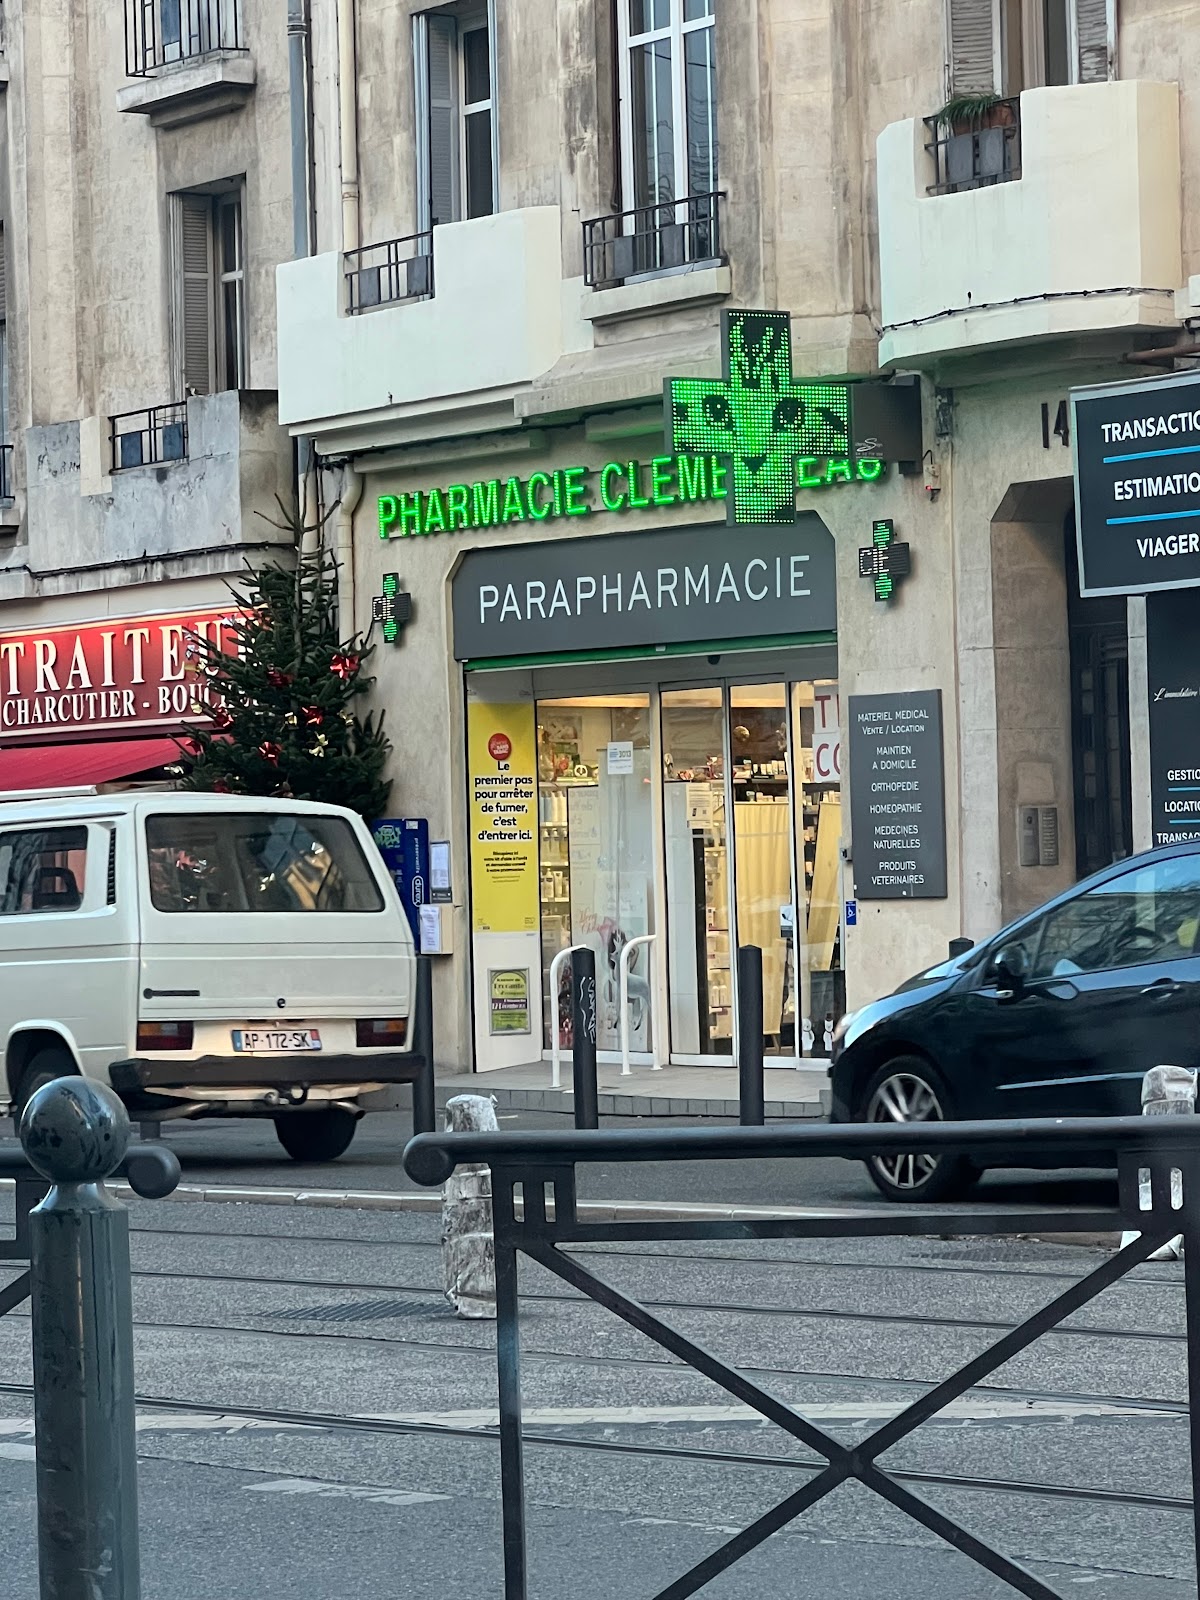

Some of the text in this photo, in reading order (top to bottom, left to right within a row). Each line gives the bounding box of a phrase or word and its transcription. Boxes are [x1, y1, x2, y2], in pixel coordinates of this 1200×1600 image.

[378, 466, 590, 539] PHARMACIE
[1136, 532, 1200, 558] VIAGER
[480, 555, 811, 624] PARAPHARMACIE
[2, 689, 136, 726] CHARCUTIER
[858, 710, 929, 722] MATERIEL MEDICAL
[876, 745, 911, 755] MAINTIEN
[497, 760, 510, 771] Le
[872, 759, 917, 770] A DOMICILE
[474, 775, 533, 788] premier pas
[871, 781, 919, 791] ORTHOPEDIE
[475, 788, 533, 801] pour arrêter
[481, 802, 528, 813] de fumer,
[870, 802, 922, 813] HOMEOPATHIE
[492, 816, 517, 826] c'est
[478, 829, 532, 840] d'entrer ici.
[874, 824, 919, 835] MEDECINES
[873, 838, 921, 849] NATURELLES
[879, 861, 916, 871] PRODUITS
[871, 874, 924, 885] VETERINAIRES
[245, 1032, 310, 1049] AP-172-SK
